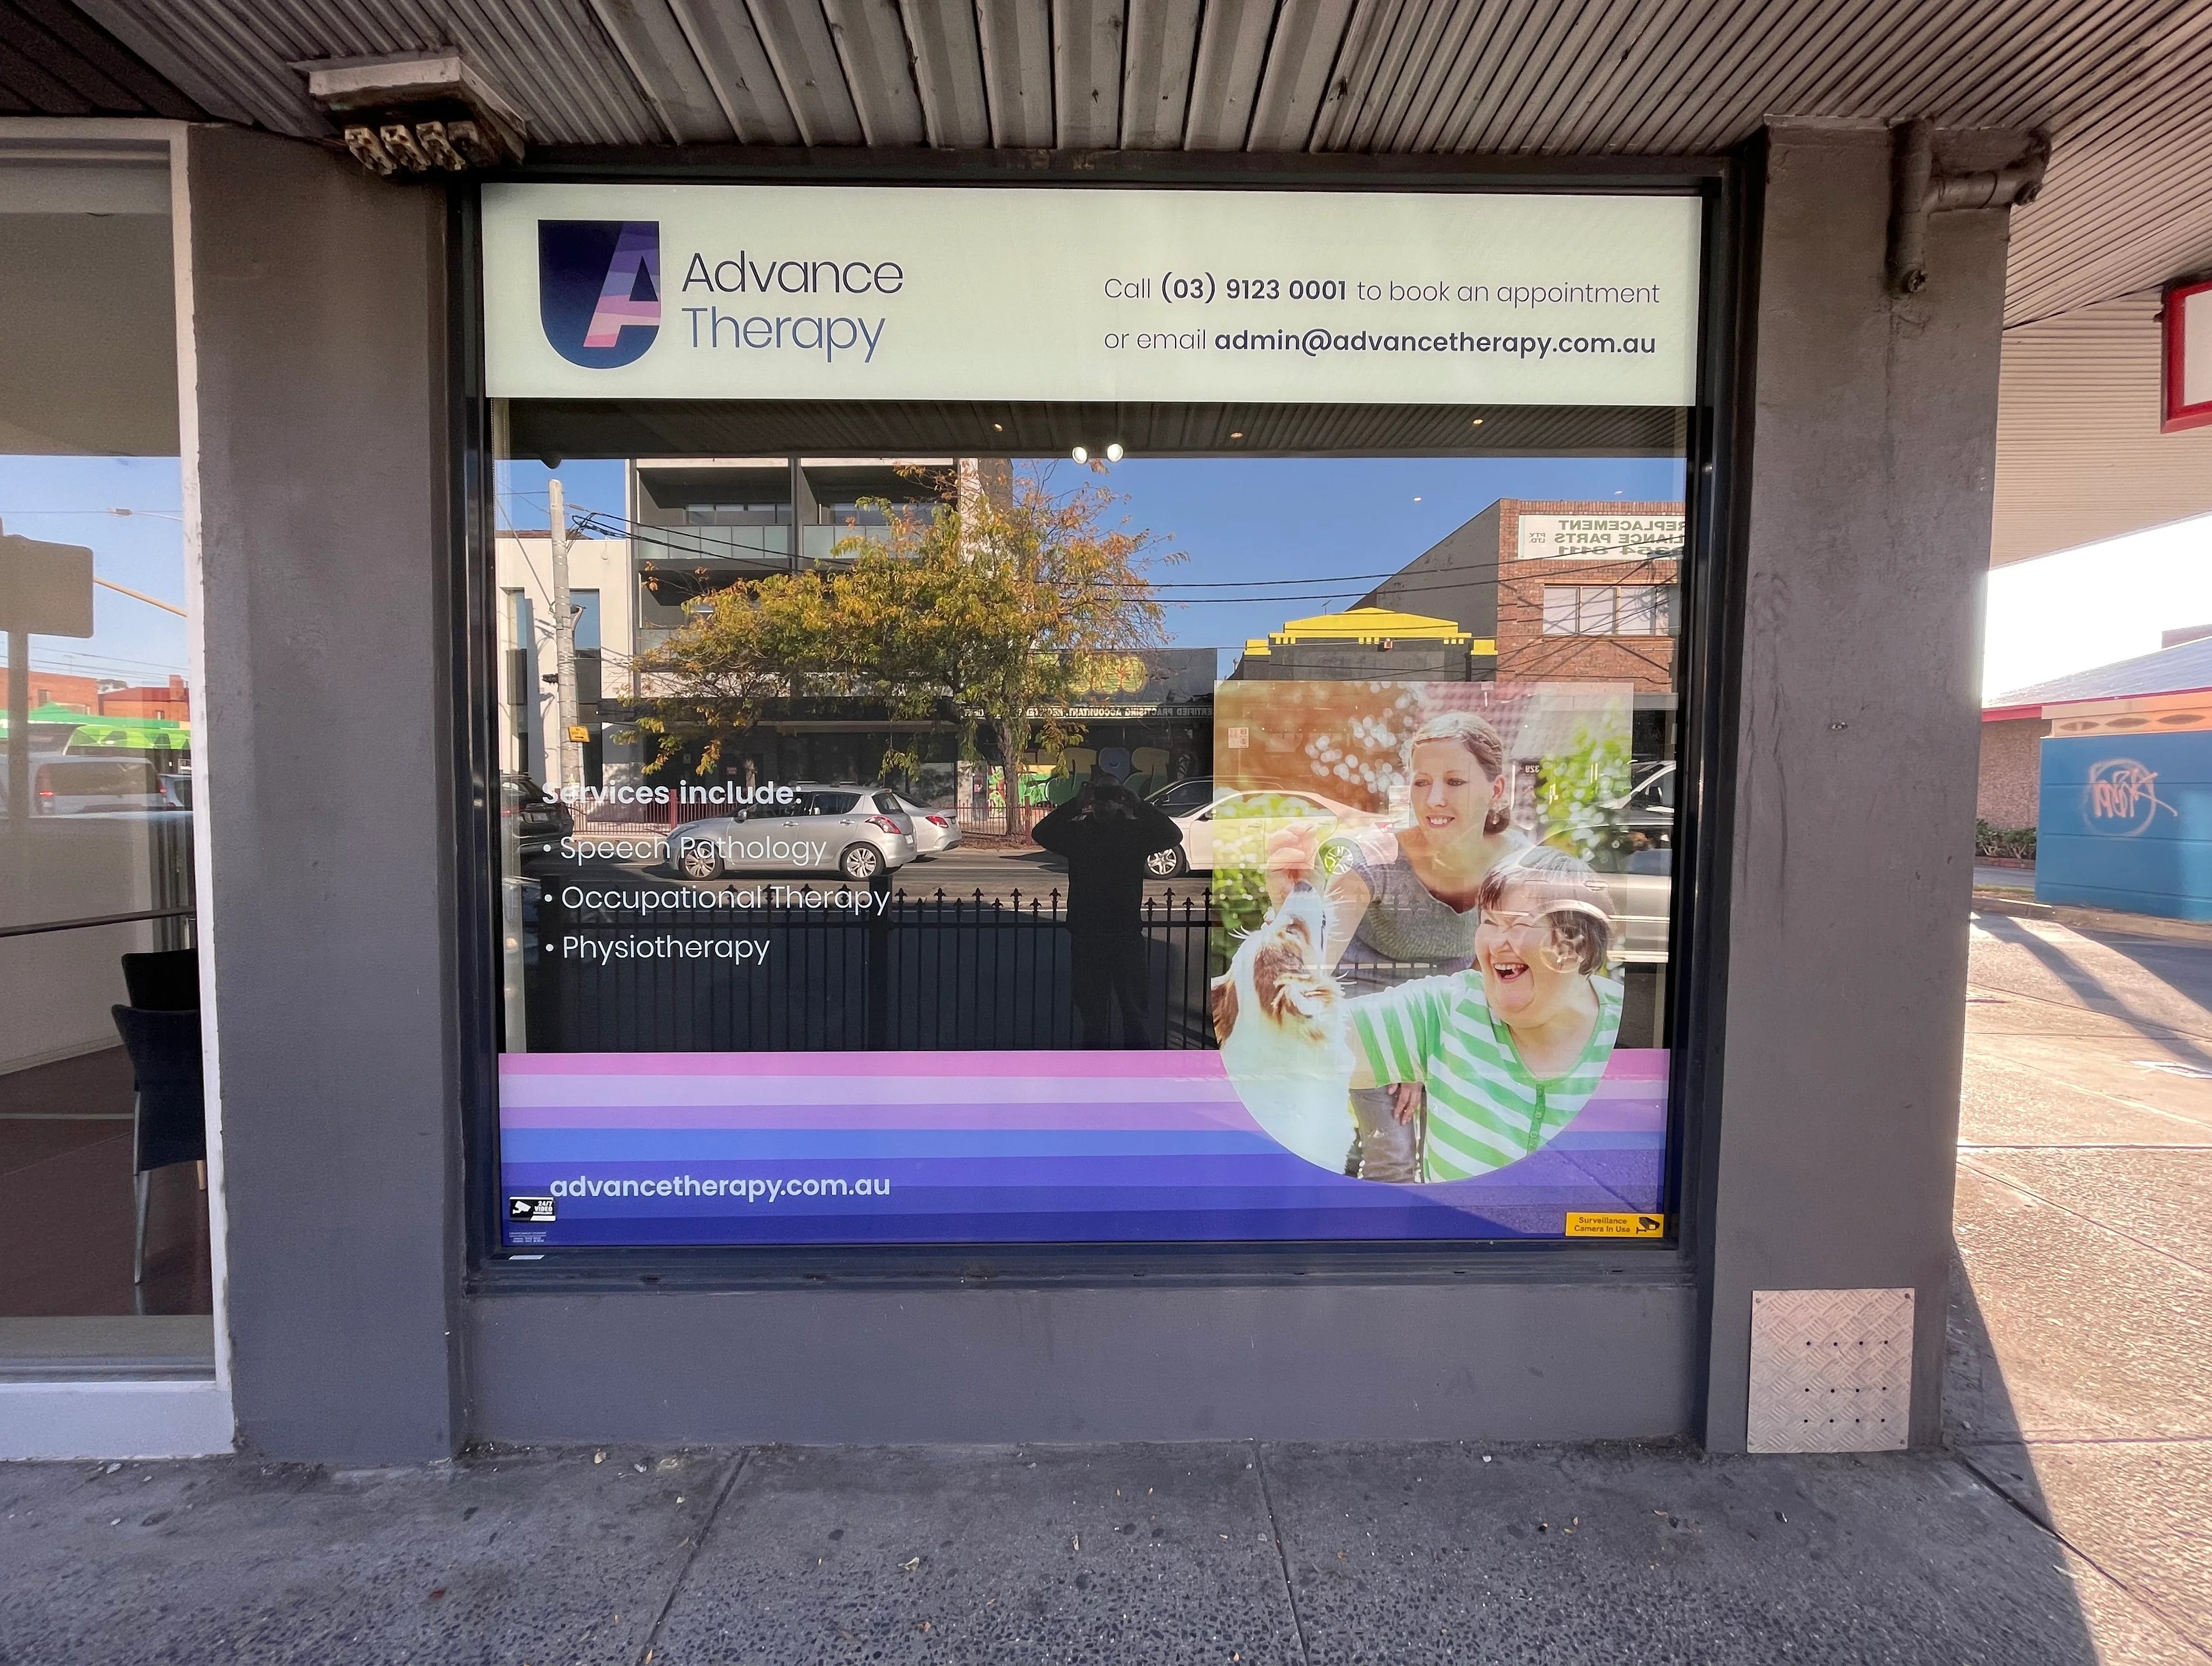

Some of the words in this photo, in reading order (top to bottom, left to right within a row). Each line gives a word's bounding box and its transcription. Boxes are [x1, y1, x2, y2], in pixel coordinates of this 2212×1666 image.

[682, 250, 903, 294] Advance
[1105, 273, 1150, 299] Call
[1161, 272, 1216, 304] (03)
[1226, 279, 1279, 300] 9123
[1289, 280, 1346, 300] 0001
[1357, 282, 1381, 301] to
[1390, 280, 1450, 302] book
[1457, 286, 1489, 302] an
[1497, 282, 1660, 309] appointment
[682, 306, 886, 363] Therapy
[1105, 333, 1129, 349] or
[1137, 328, 1206, 350] email
[1215, 328, 1655, 359] admin@advancetherapy.com.au
[542, 779, 670, 804] Services
[680, 779, 802, 805] include:
[560, 836, 671, 867] Speech
[680, 835, 827, 867] Pathology
[561, 884, 762, 916] Occupational
[770, 885, 890, 916] Therapy
[563, 934, 771, 966] Physiotherapy
[549, 1175, 891, 1203] advancetherapy.com.au
[1578, 1216, 1627, 1225] Surveillance
